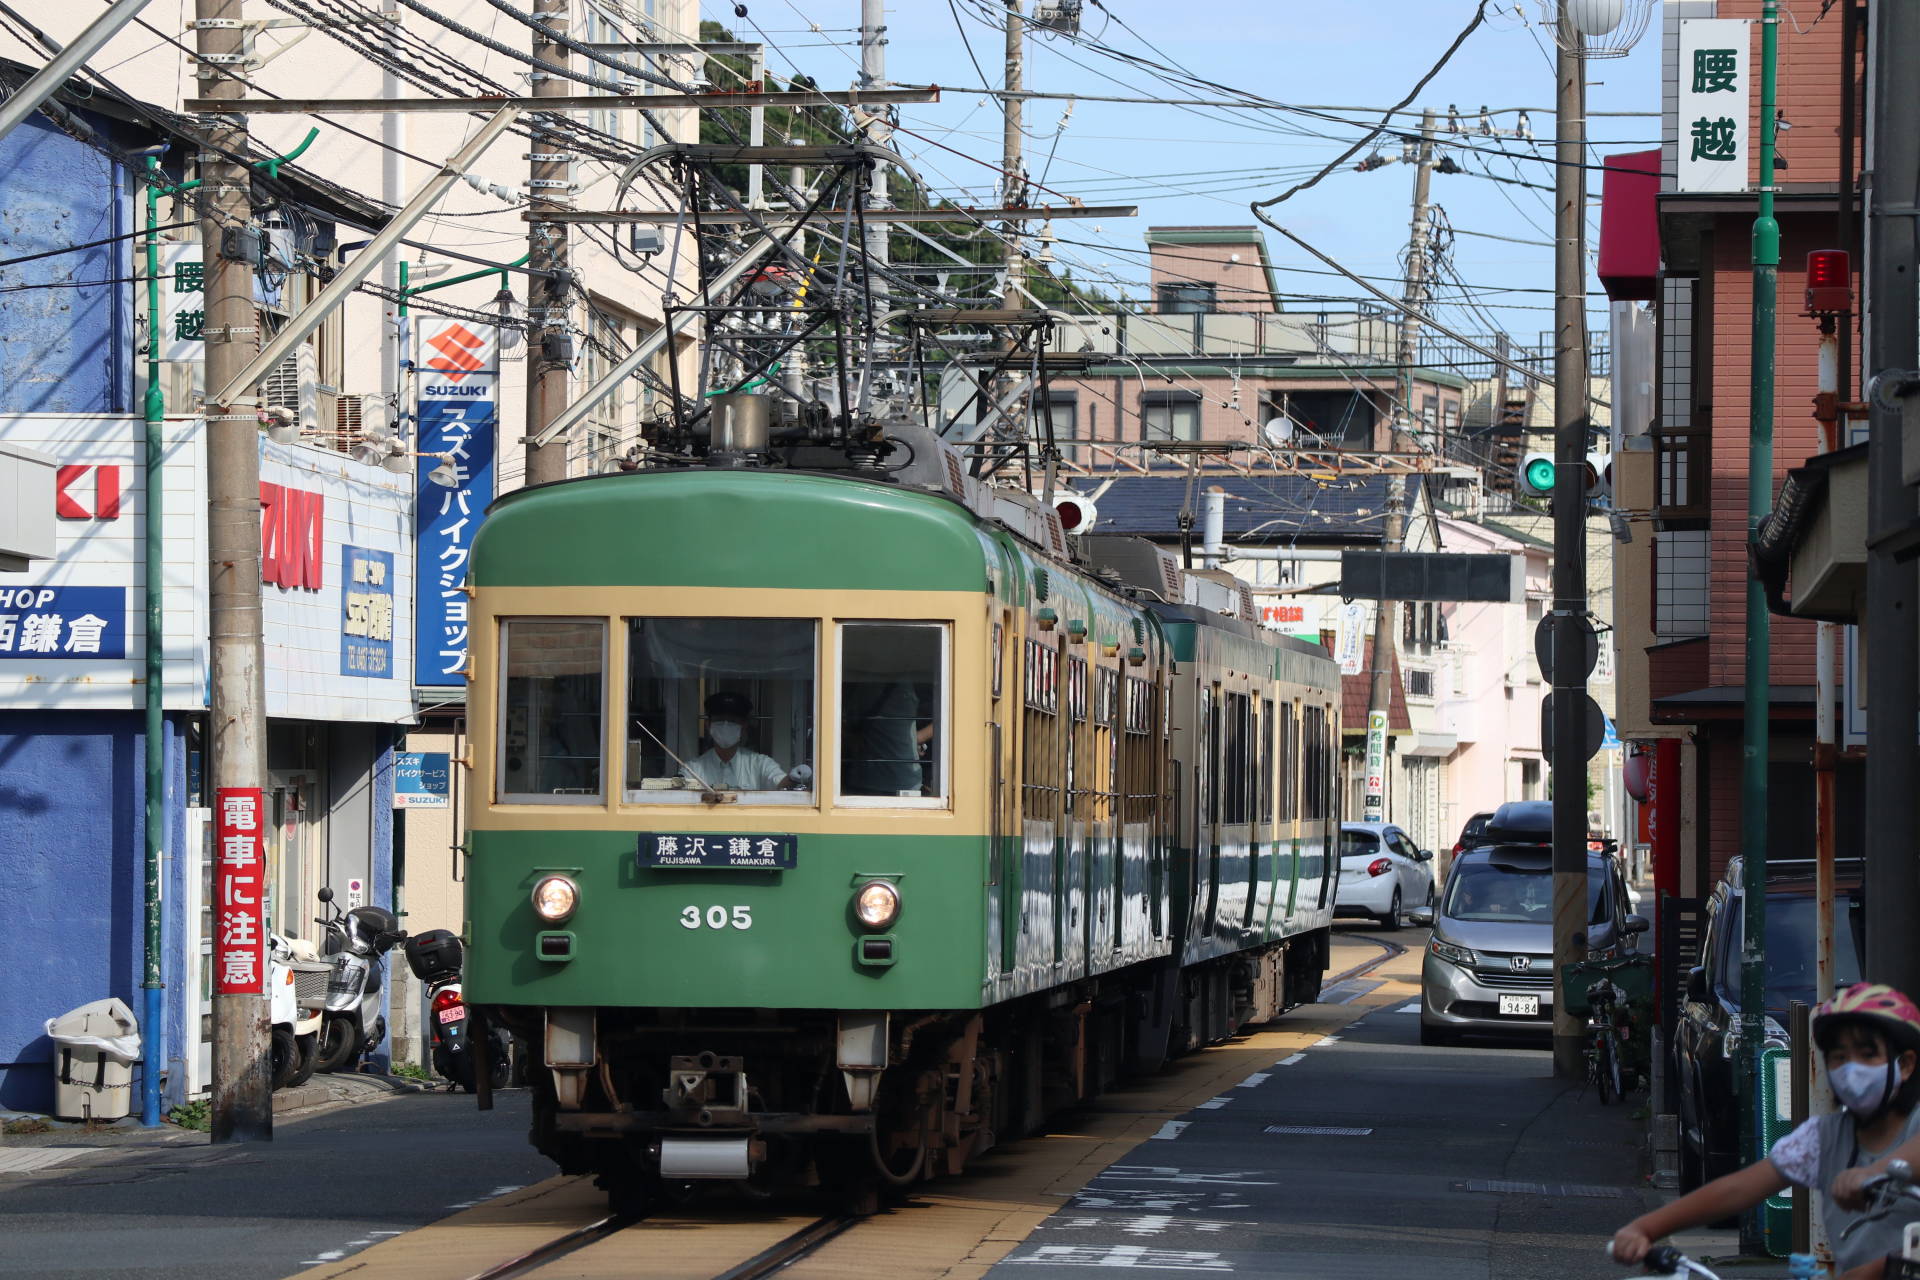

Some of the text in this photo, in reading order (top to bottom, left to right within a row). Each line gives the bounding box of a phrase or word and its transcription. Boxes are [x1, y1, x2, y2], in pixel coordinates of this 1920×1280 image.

[1690, 48, 1738, 163] 腰越
[174, 261, 205, 342] 腰越
[425, 384, 488, 397] SUZUKI
[397, 769, 447, 778] バイクサービス
[408, 796, 448, 804] SUZUKI
[660, 856, 776, 866] FUJISAWA KAMAKURA
[222, 796, 257, 985] 電車に注意
[679, 905, 753, 930] 305
[1507, 1002, 1537, 1014] 94-84
